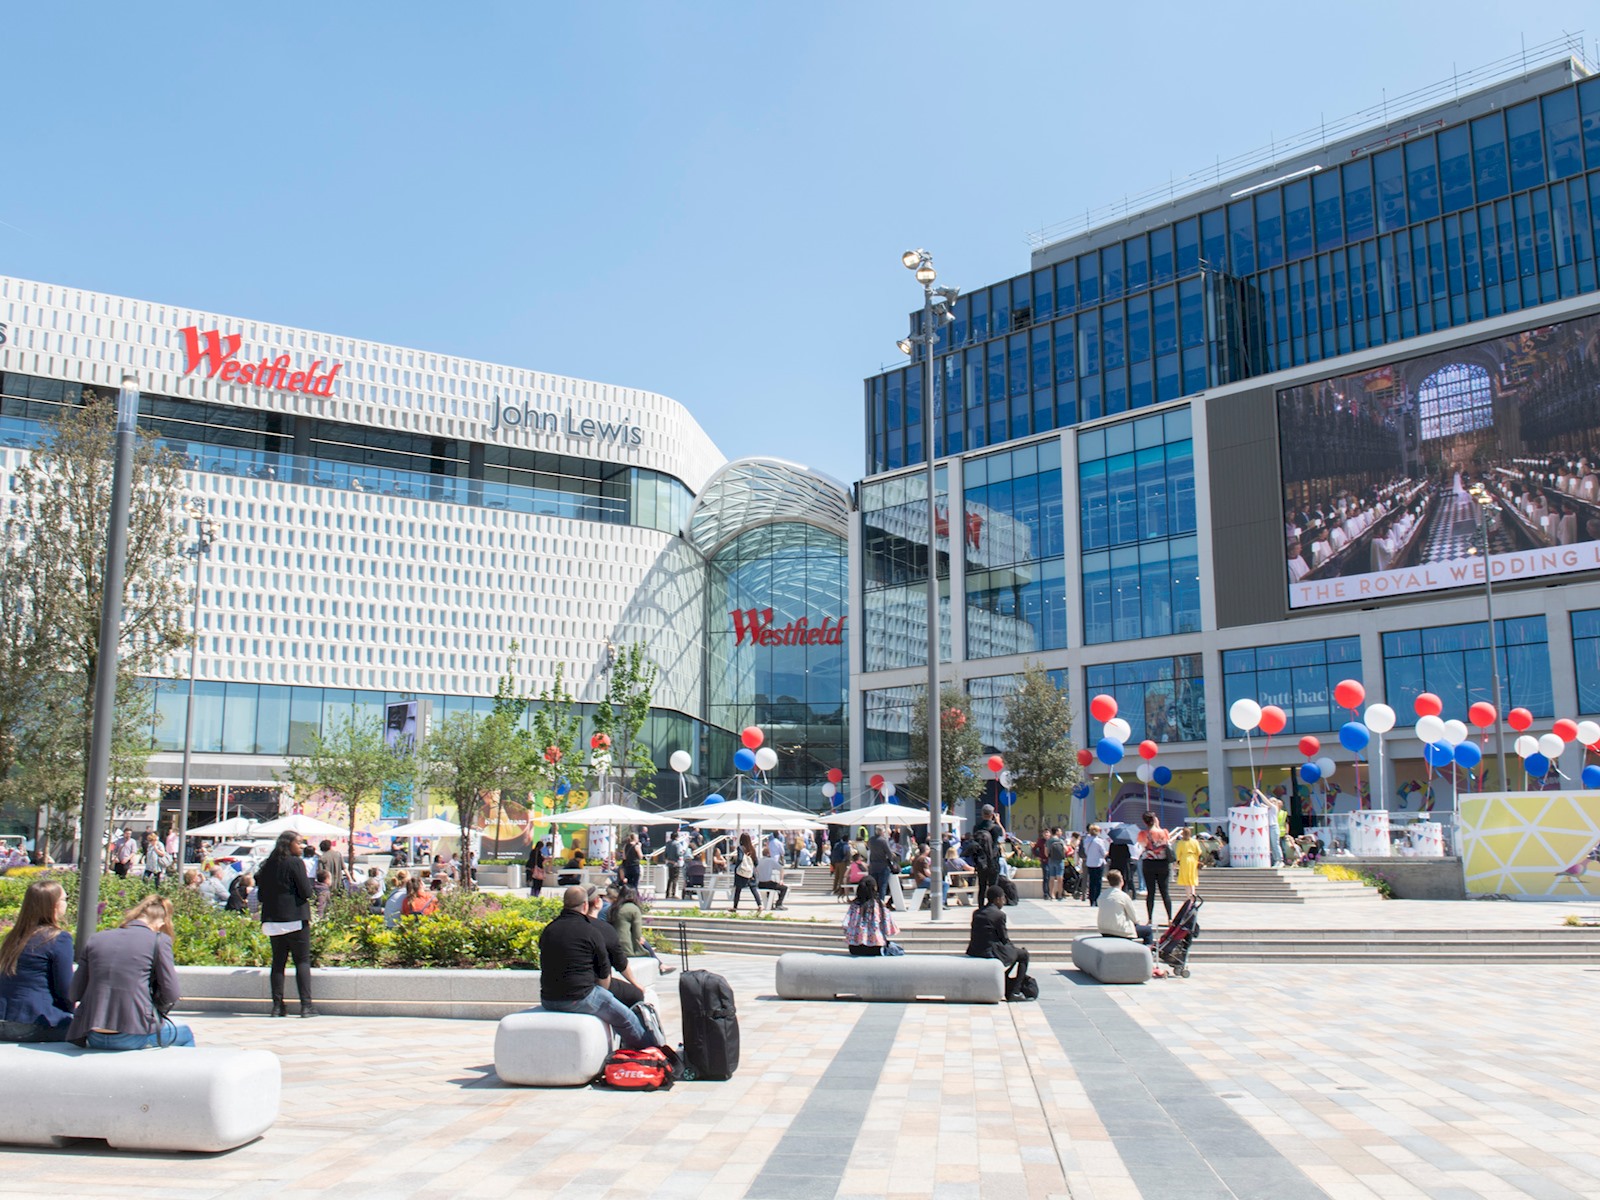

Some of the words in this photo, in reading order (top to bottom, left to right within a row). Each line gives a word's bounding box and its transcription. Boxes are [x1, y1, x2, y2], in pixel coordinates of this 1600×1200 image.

[178, 326, 343, 397] Westfield
[491, 394, 557, 432] John
[567, 406, 642, 445] Lewis
[1301, 582, 1346, 602] THE
[1359, 570, 1437, 594] ROYAL
[1449, 550, 1579, 582] WEDDING
[728, 607, 848, 647] Westfield
